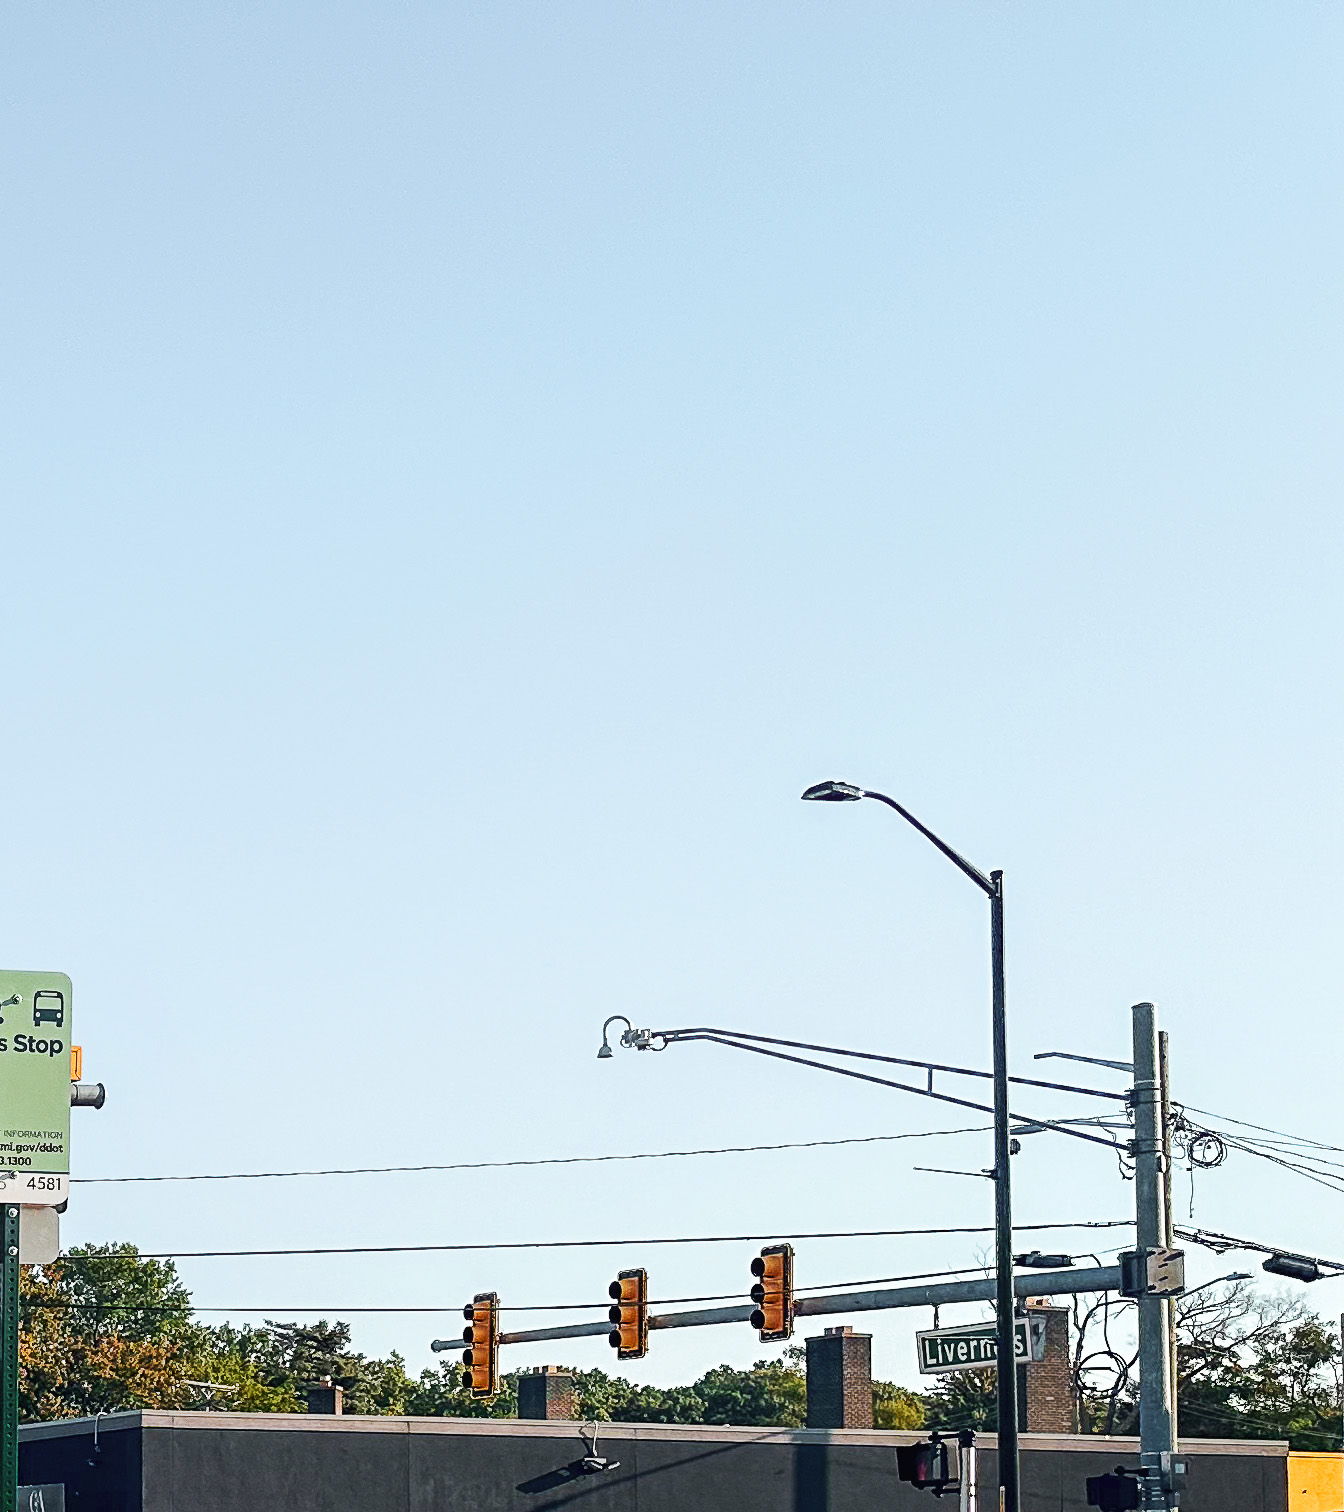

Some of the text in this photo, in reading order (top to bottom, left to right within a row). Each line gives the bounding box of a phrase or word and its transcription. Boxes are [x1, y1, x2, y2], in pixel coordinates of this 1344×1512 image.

[12, 1033, 64, 1057] Stop
[3, 1129, 64, 1140] INFORMATION
[26, 1176, 62, 1191] 4581
[924, 1333, 1024, 1365] Liverns
